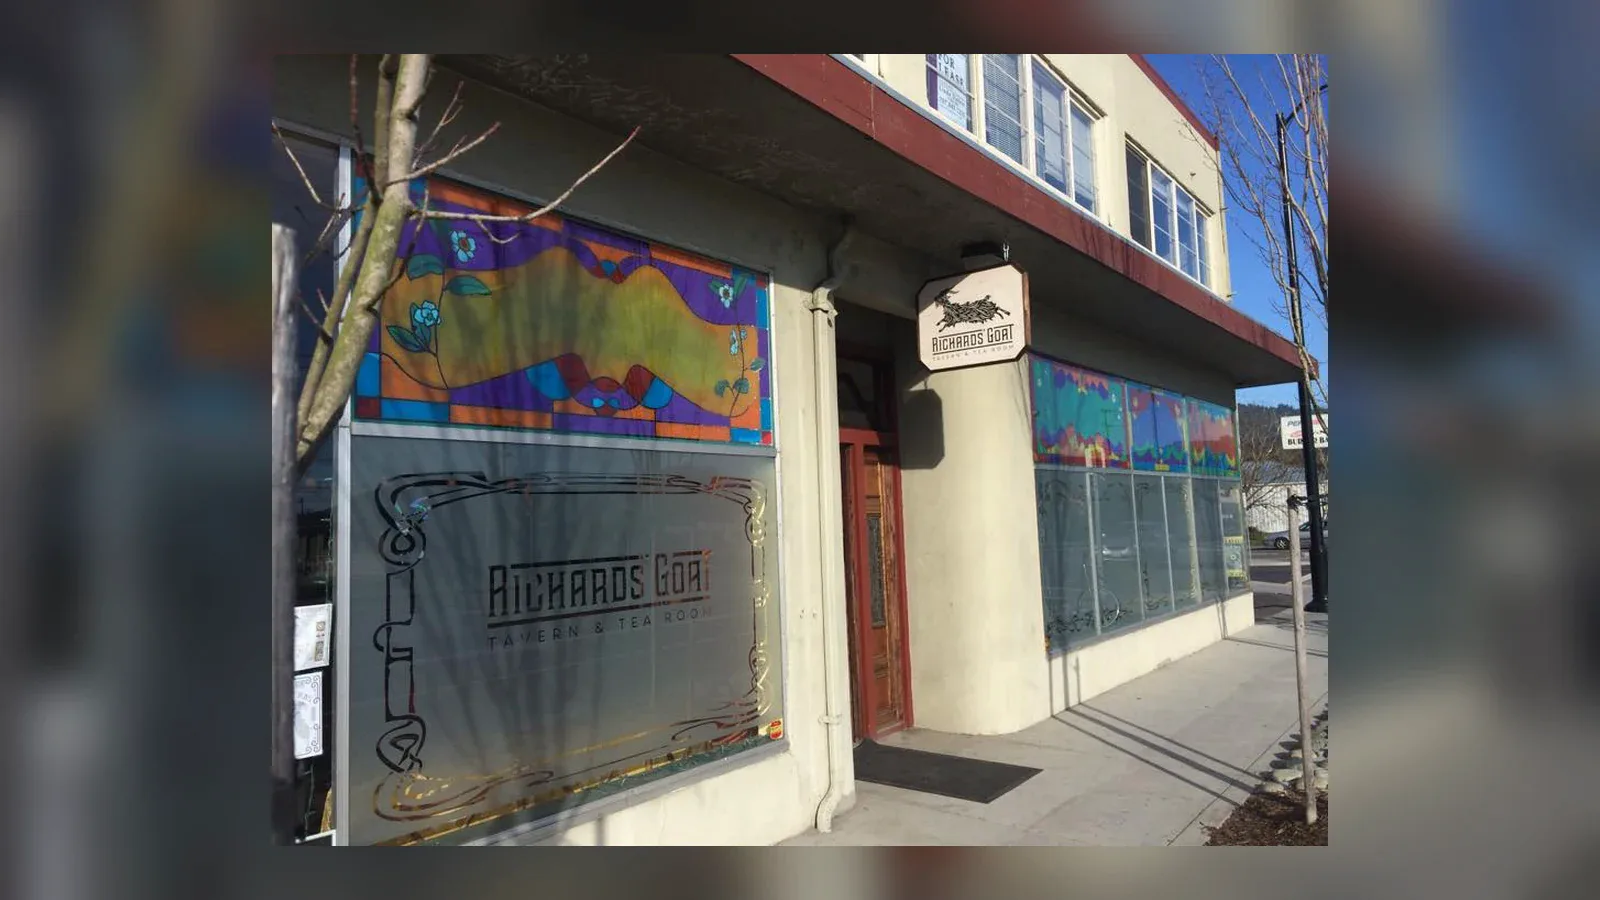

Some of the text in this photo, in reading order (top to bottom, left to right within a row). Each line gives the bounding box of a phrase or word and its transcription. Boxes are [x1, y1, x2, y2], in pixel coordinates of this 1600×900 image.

[487, 606, 712, 652] TAVERN & TEA ROOM
